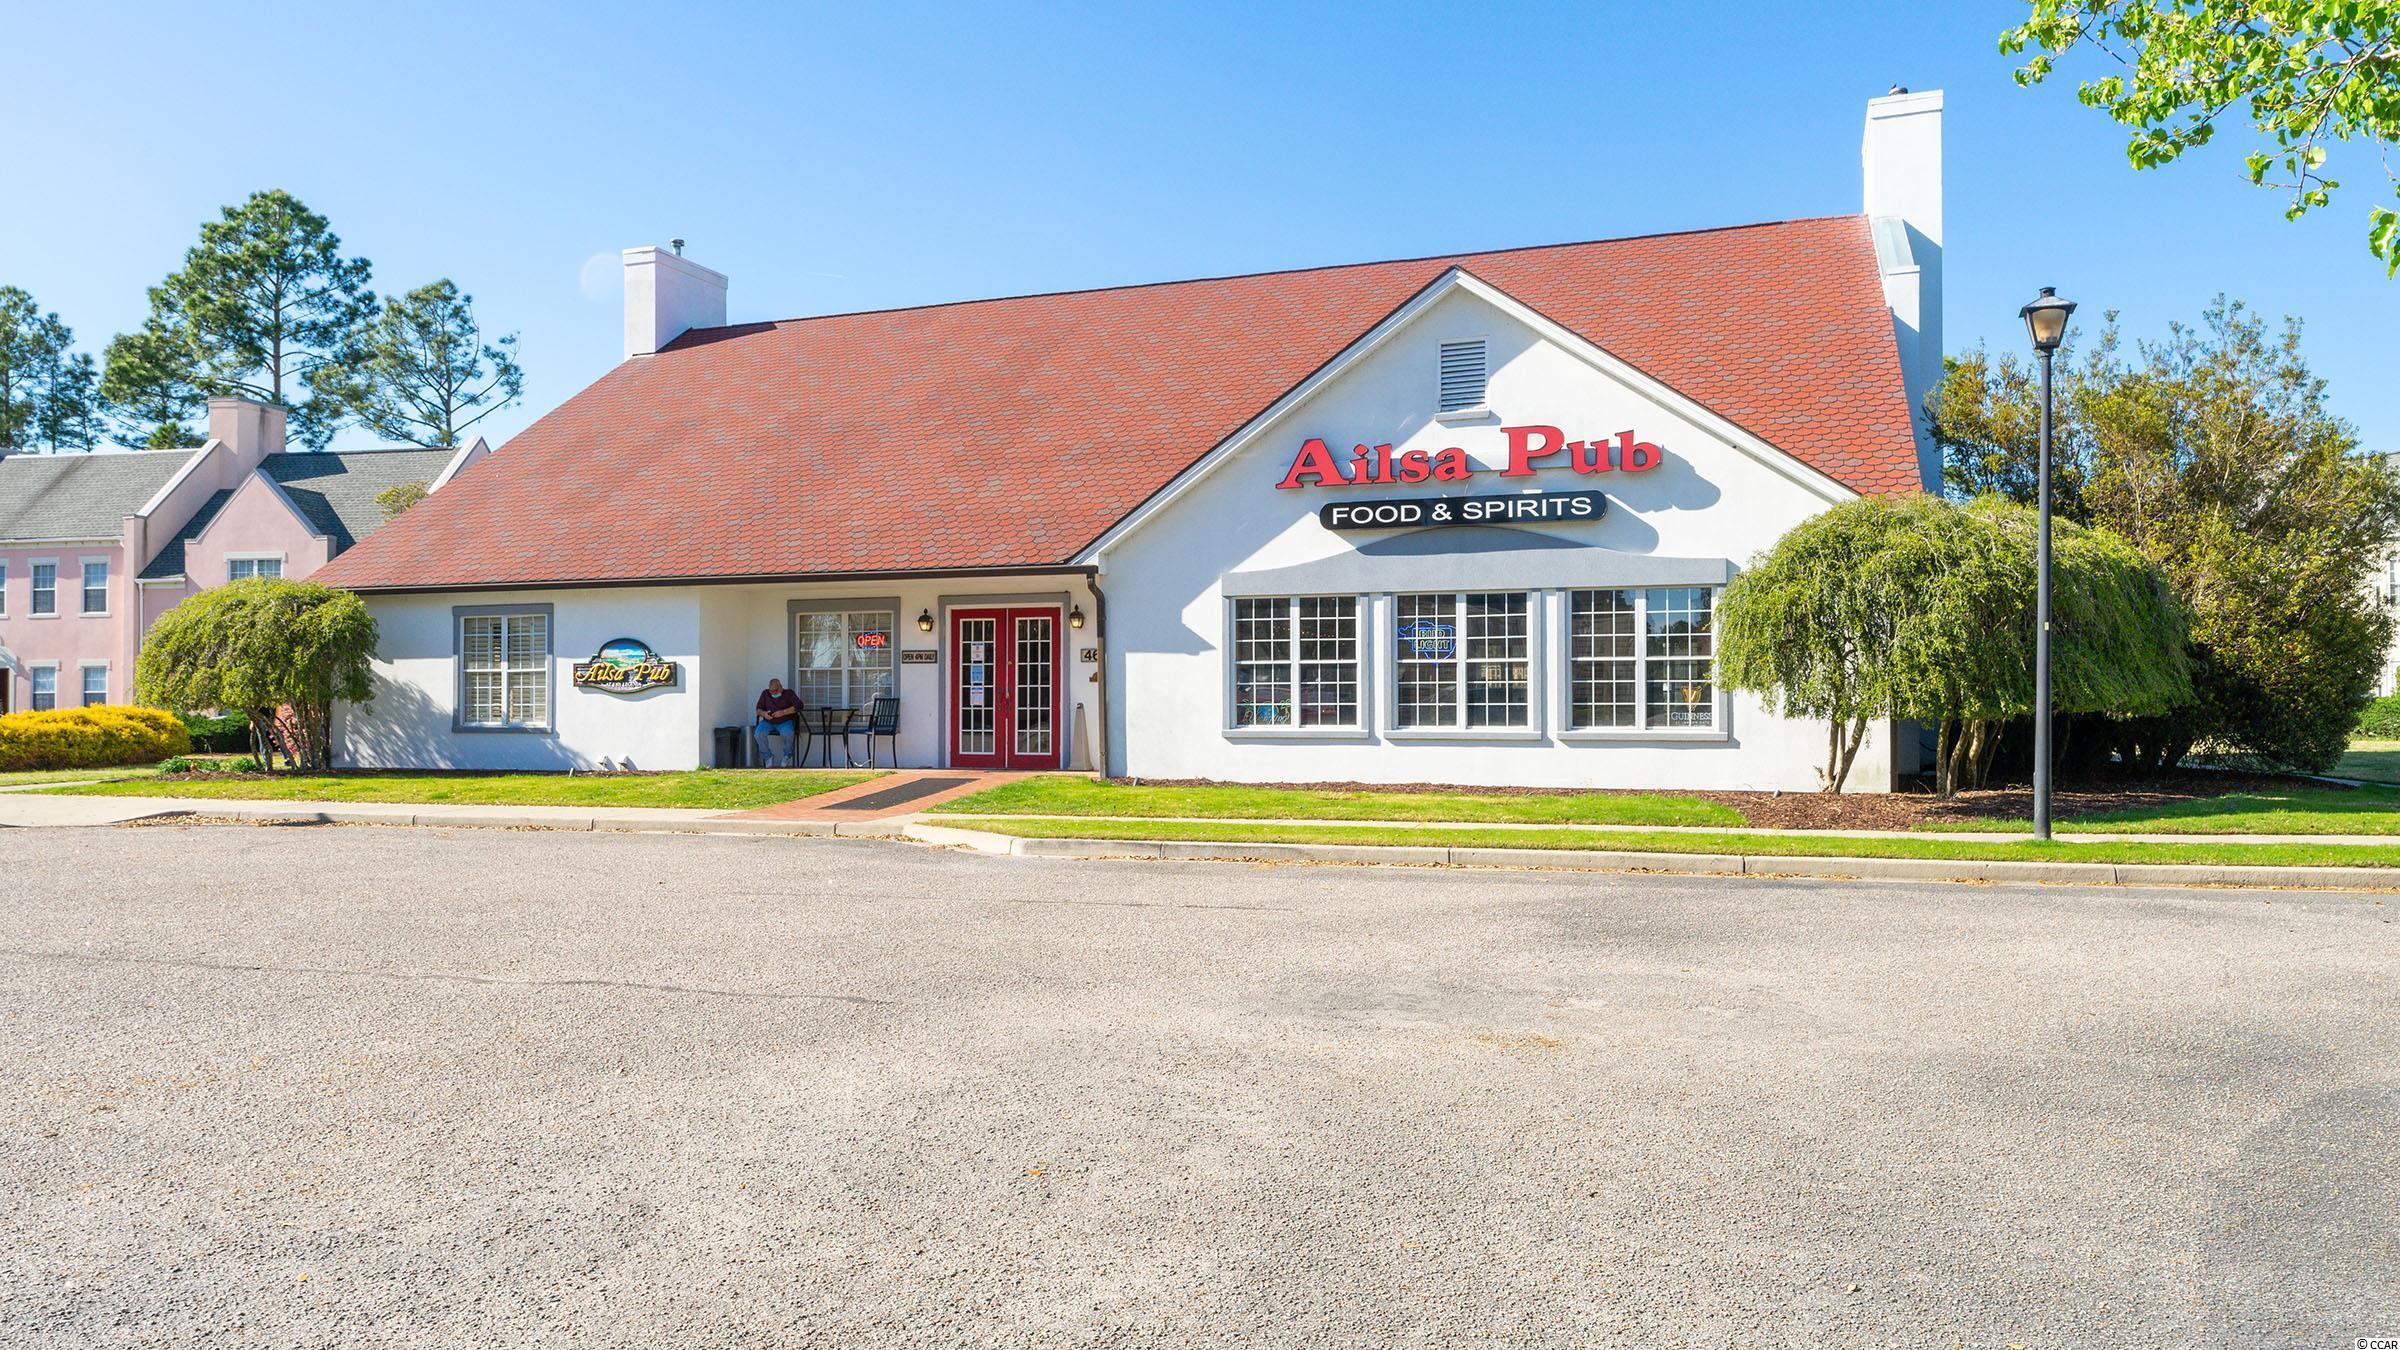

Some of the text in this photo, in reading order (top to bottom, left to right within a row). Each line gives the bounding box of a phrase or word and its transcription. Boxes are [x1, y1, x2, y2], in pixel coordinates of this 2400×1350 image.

[1276, 425, 1662, 489] Ailsa Pub
[1332, 497, 1592, 525] FOOD & SPIRITS
[857, 635, 885, 646] OPEN
[903, 653, 914, 661] OPEN
[575, 663, 671, 681] Ailsa Pub
